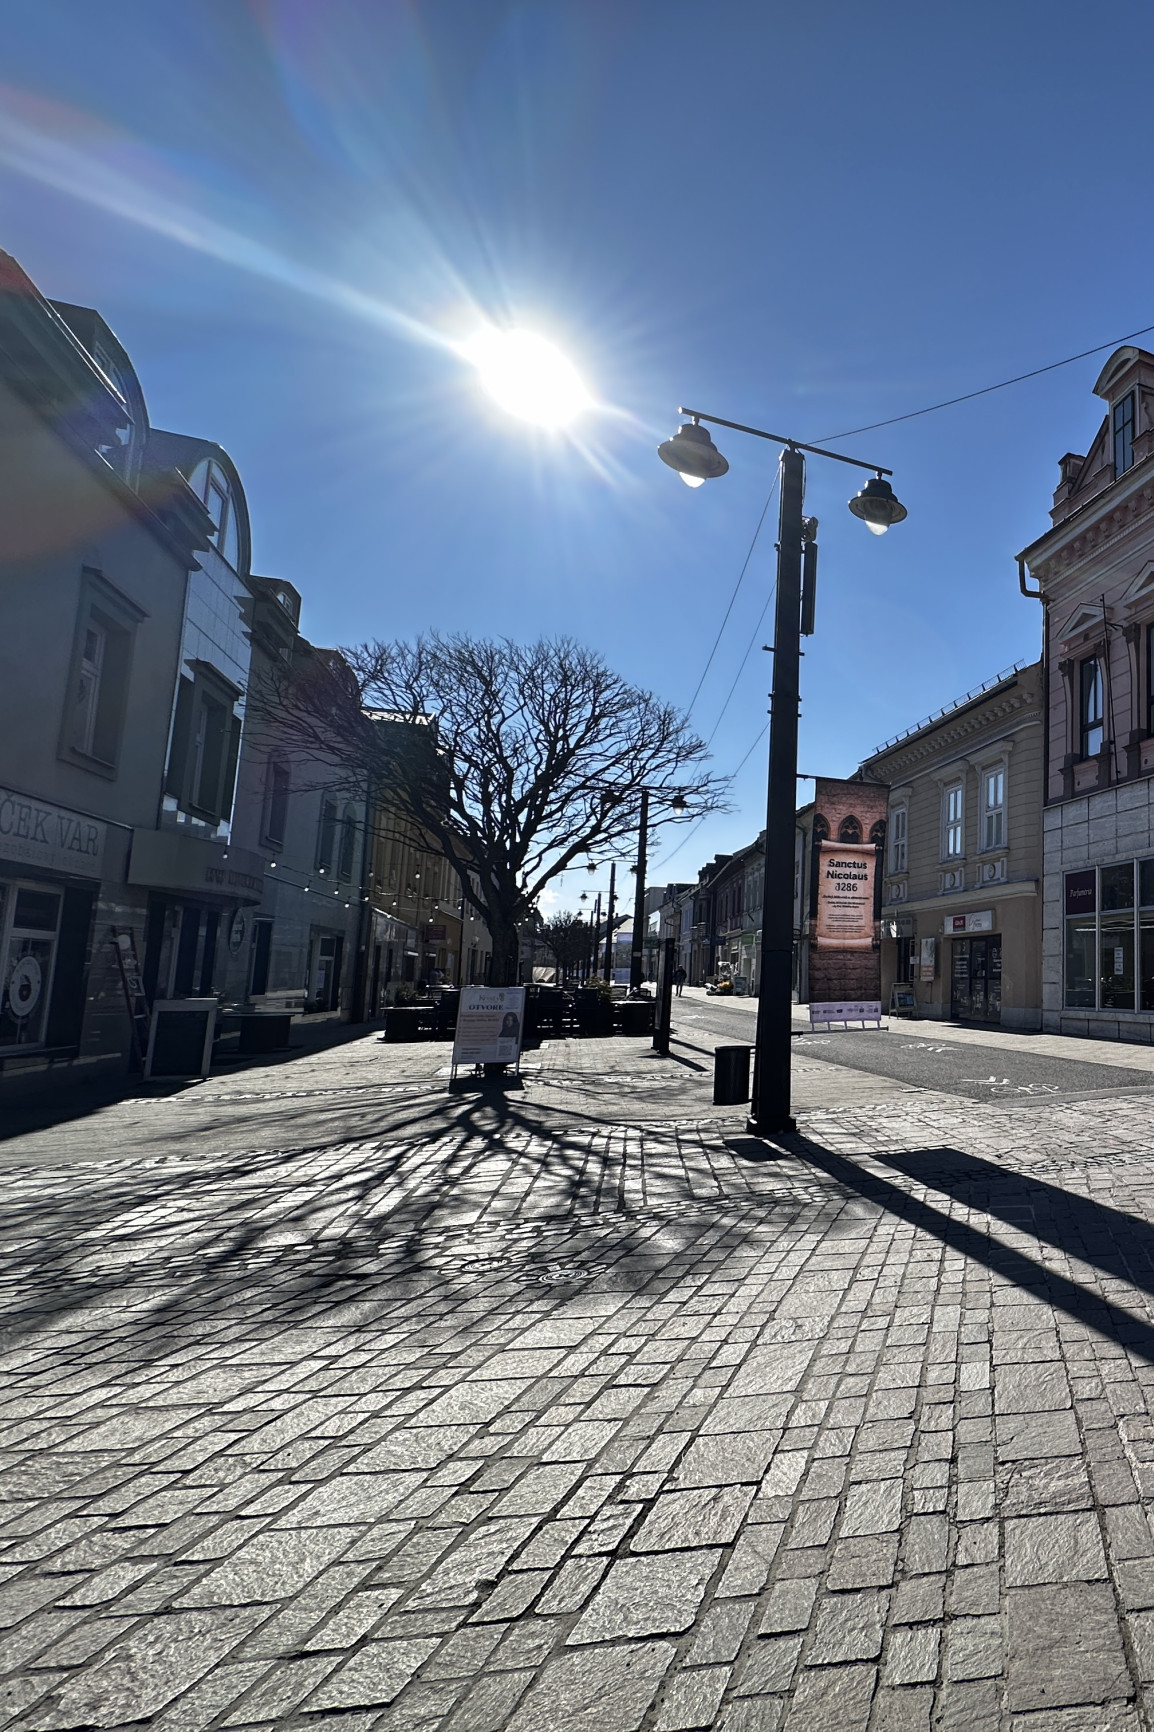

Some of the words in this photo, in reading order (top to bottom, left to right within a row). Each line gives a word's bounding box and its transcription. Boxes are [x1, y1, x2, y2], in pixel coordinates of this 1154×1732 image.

[57, 814, 98, 855] VAR
[828, 858, 868, 870] Sanctus
[826, 870, 869, 881] Nicolaus
[835, 882, 859, 892] 1286
